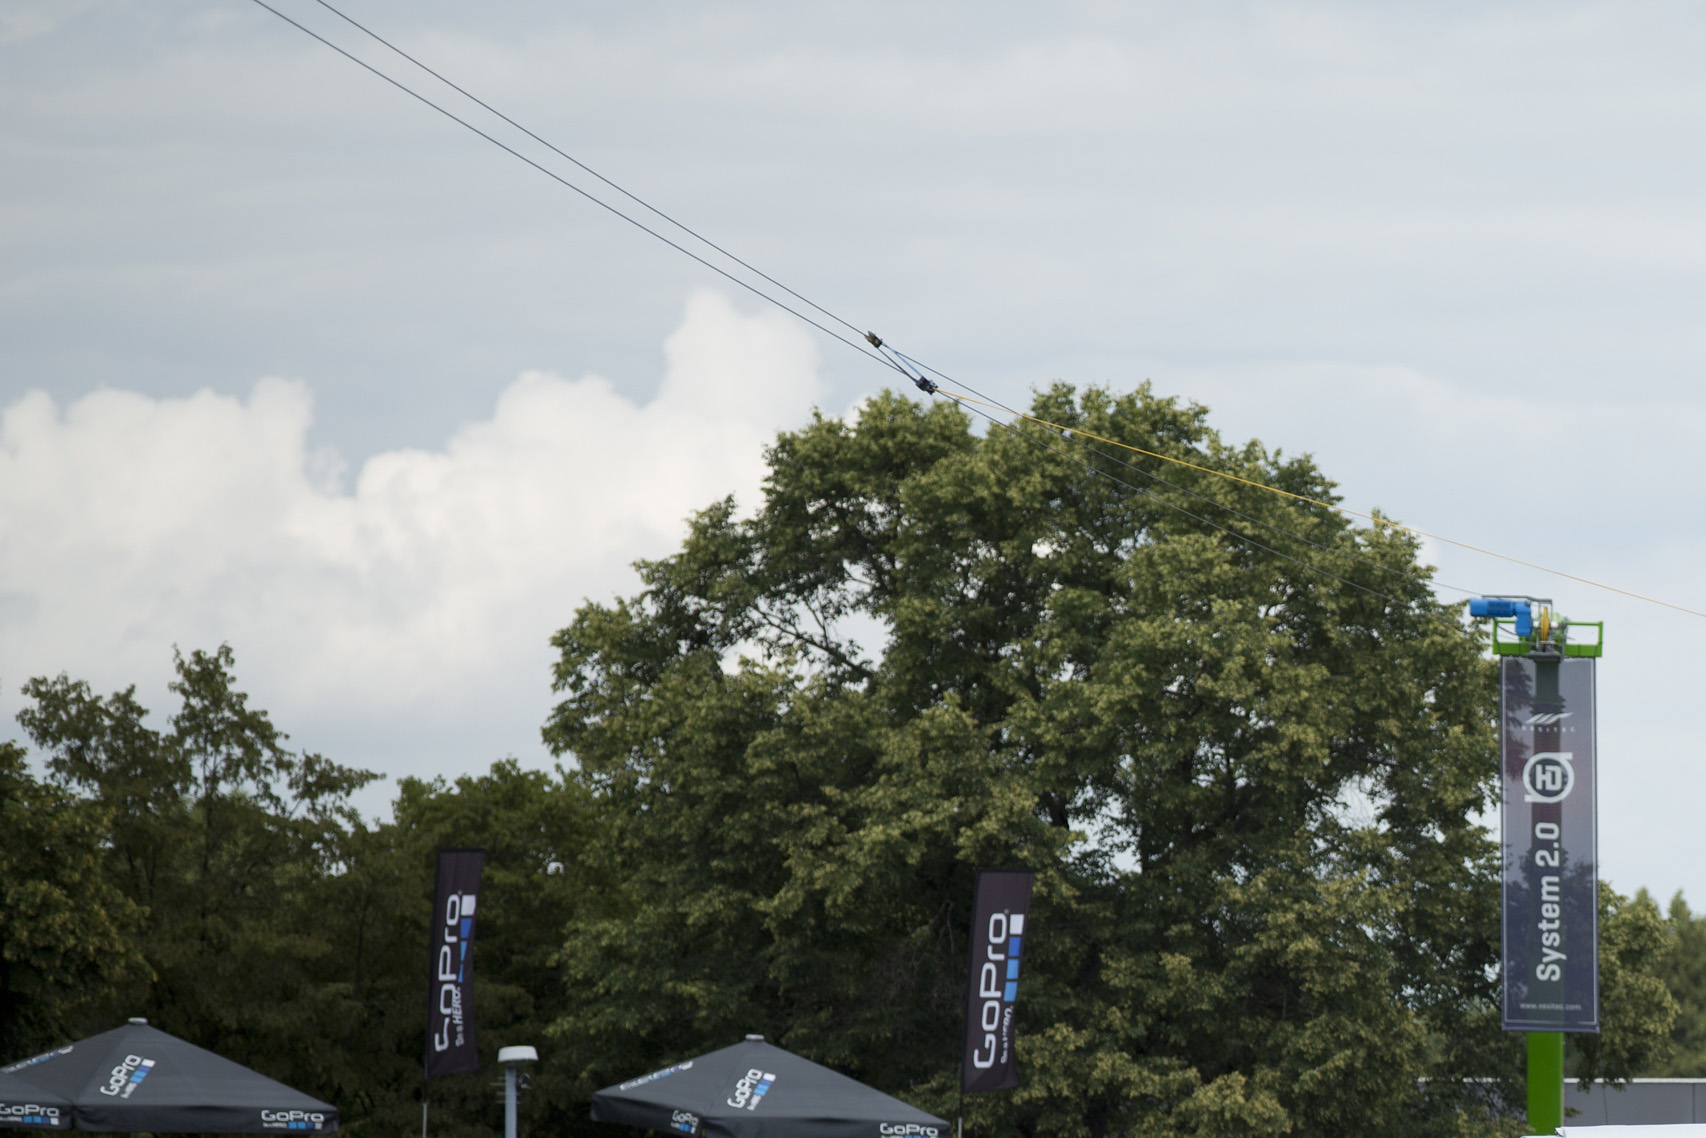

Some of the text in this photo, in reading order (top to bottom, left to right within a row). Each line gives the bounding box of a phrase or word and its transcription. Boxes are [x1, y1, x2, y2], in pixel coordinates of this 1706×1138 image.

[1535, 822, 1567, 982] System 2.0
[973, 912, 1008, 1069] GoPro
[100, 1054, 142, 1096] GoPro
[727, 1068, 763, 1109] GoPro
[261, 1109, 324, 1122] GoPro
[880, 1122, 939, 1137] GoPro
